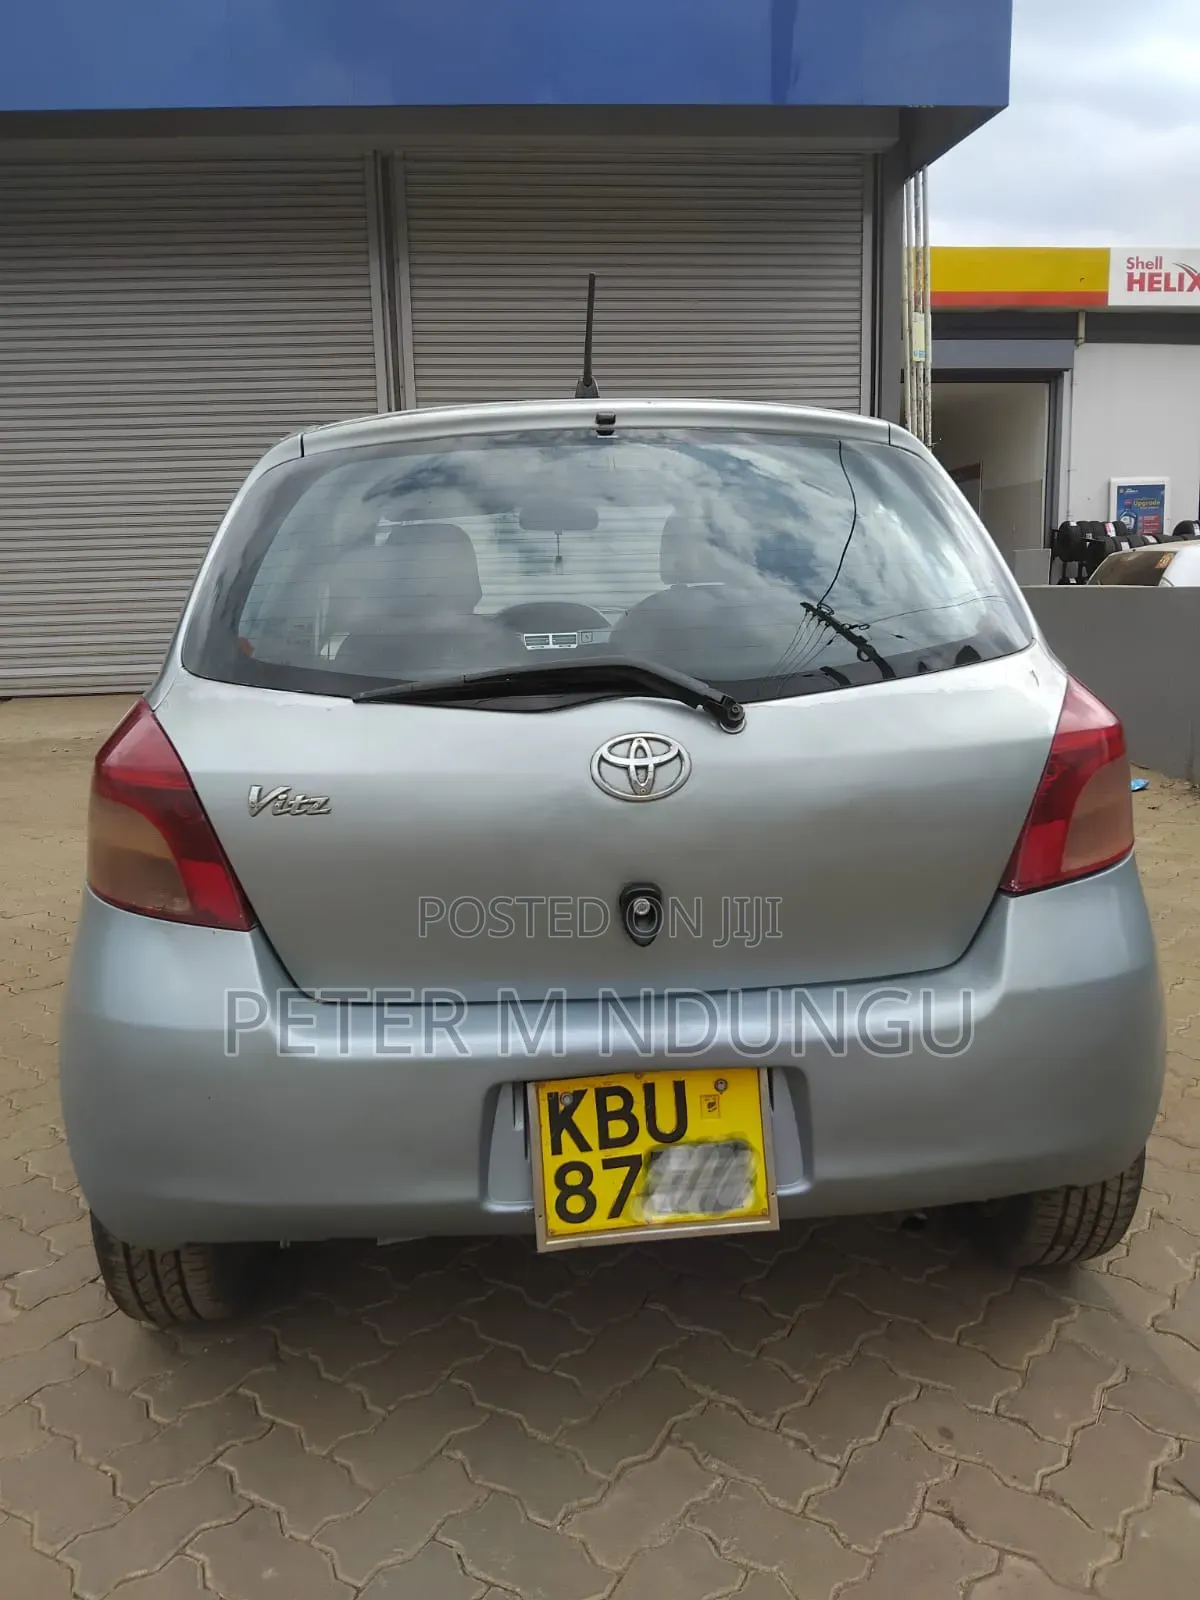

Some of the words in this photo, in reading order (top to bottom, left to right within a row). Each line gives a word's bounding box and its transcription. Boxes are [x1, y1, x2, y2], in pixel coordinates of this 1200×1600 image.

[1126, 255, 1163, 270] Shell
[1126, 267, 1200, 292] HELIX
[247, 784, 332, 817] Vitz
[547, 1080, 688, 1155] KBU
